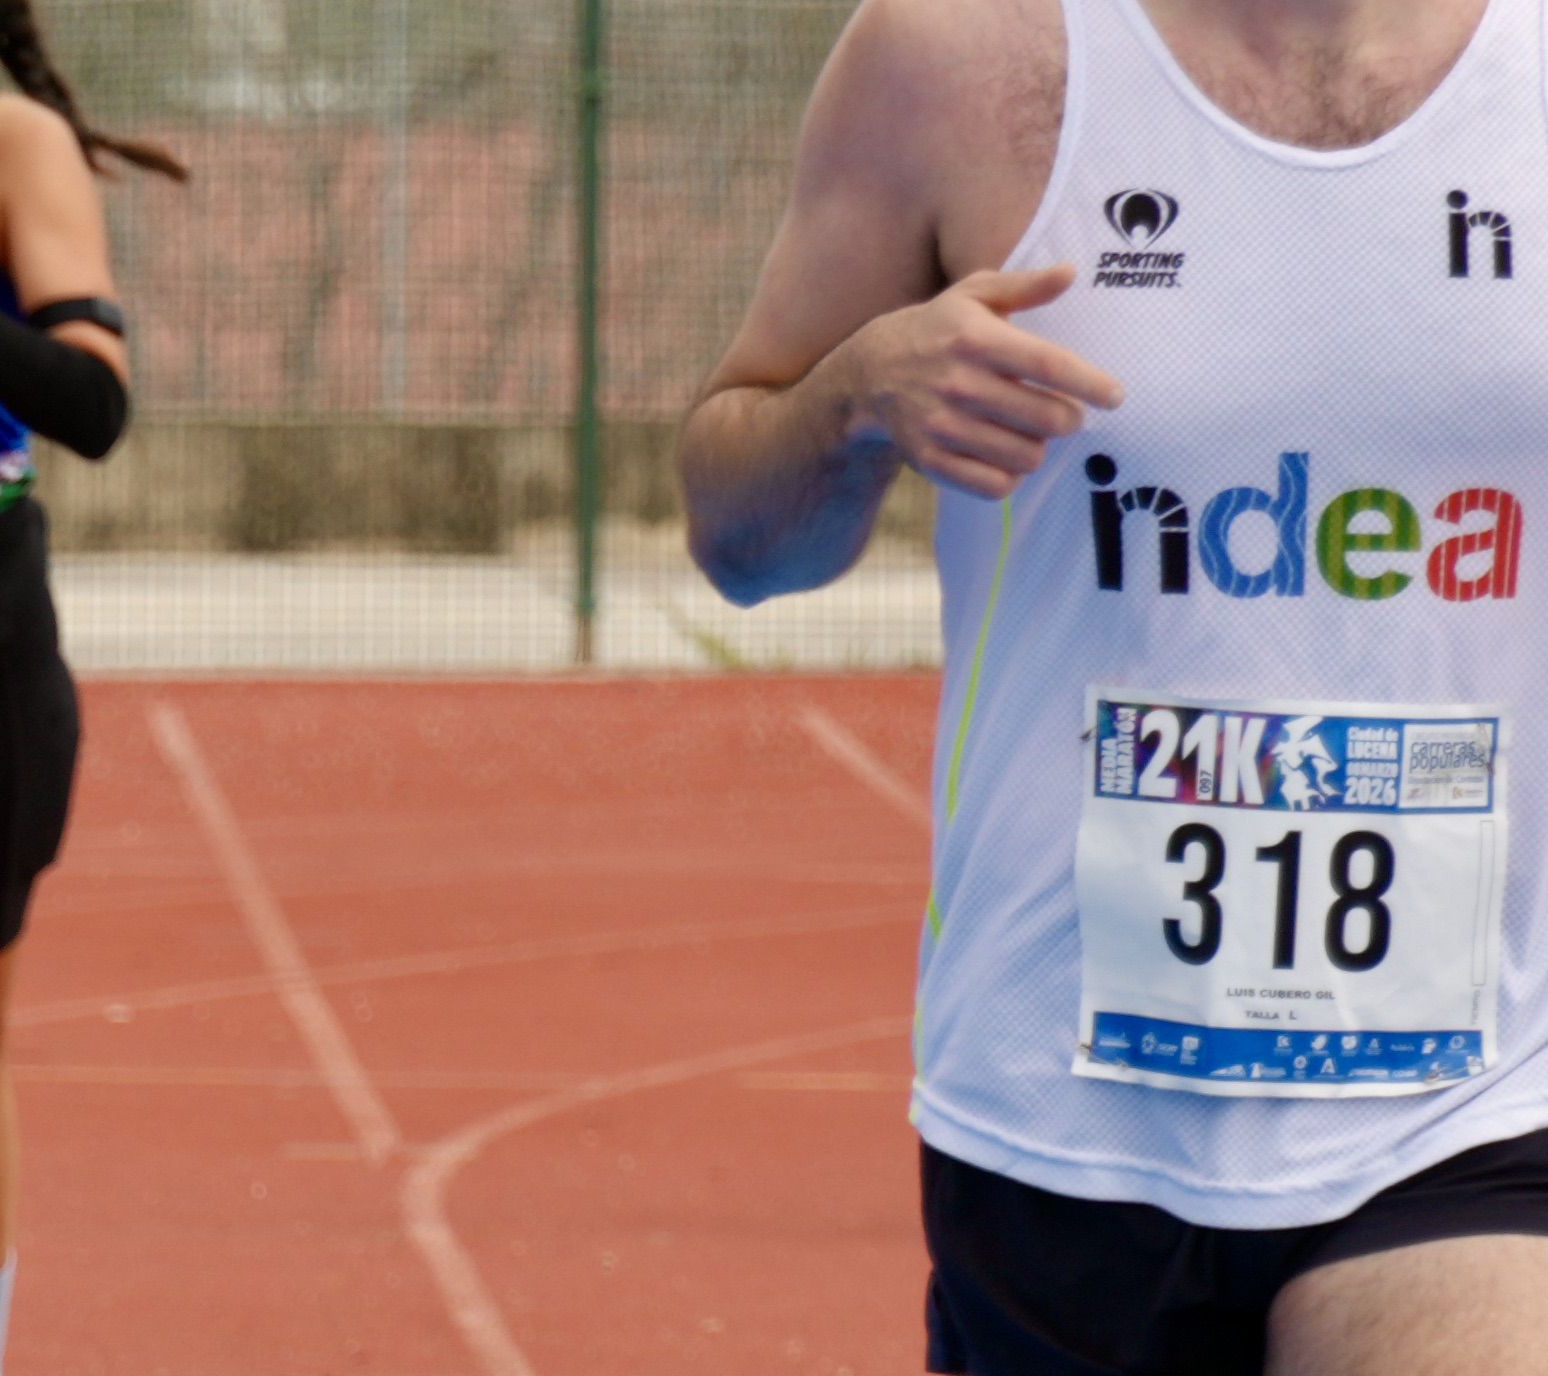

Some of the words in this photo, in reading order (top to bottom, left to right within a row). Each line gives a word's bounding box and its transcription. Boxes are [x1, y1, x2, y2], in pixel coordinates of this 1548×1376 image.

[1447, 190, 1513, 278] in
[1097, 251, 1185, 269] SPORTING
[1084, 451, 1523, 602] indea
[1138, 709, 1267, 805] 21K
[1411, 741, 1477, 756] carreras
[1409, 754, 1487, 774] populares
[1344, 777, 1397, 805] 2026
[1163, 822, 1395, 972] 318
[1226, 987, 1256, 998] LUIS
[1259, 988, 1312, 1000] CUBERO
[1315, 989, 1335, 1000] GIL
